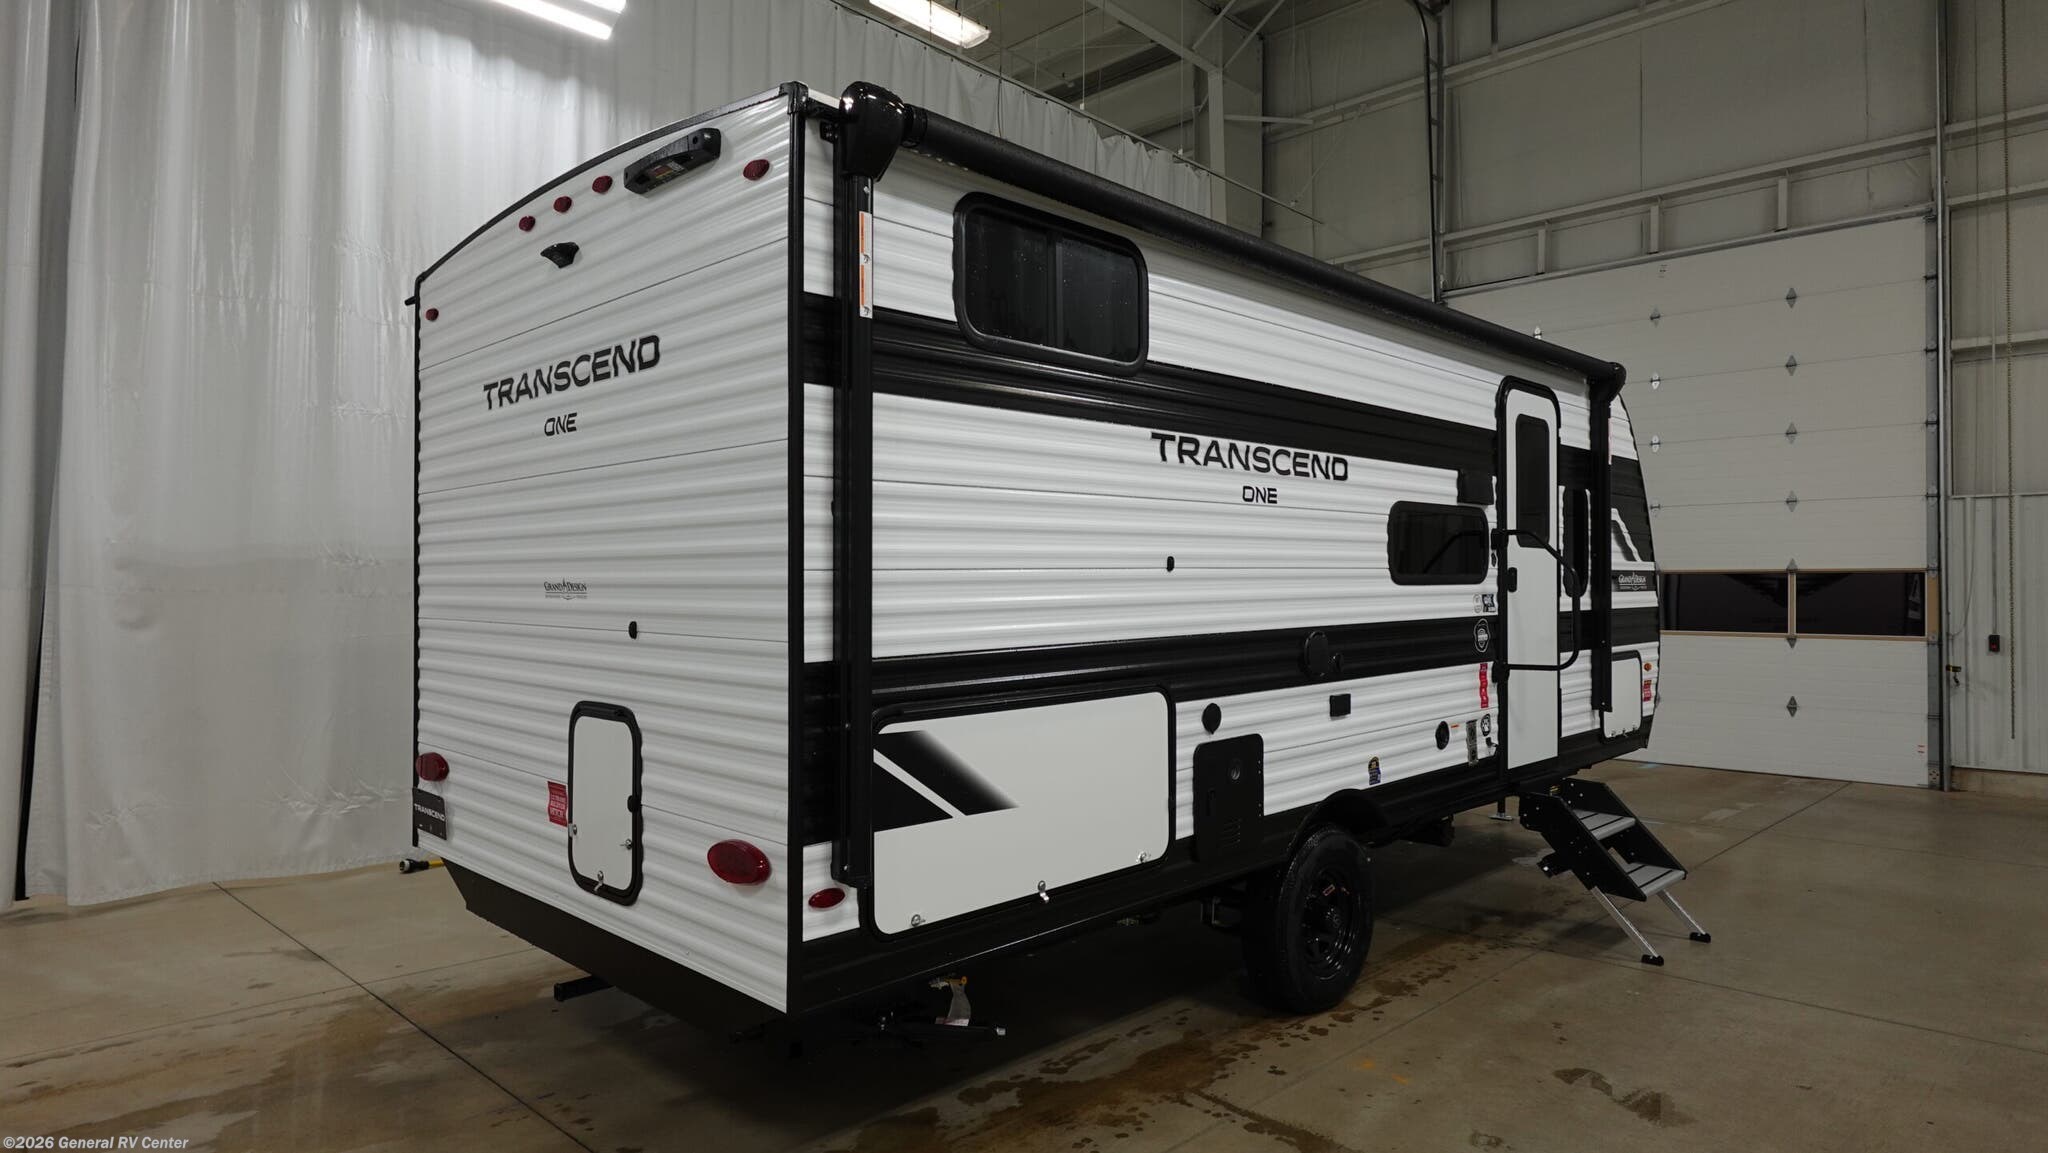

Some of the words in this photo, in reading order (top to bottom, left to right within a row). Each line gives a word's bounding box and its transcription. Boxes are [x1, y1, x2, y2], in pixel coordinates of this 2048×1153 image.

[483, 335, 660, 410] TRANSCEND
[544, 412, 577, 436] ONE
[1151, 431, 1349, 482] TRANSCEND
[1242, 485, 1278, 505] ONE
[414, 803, 446, 822] TRANSCEND
